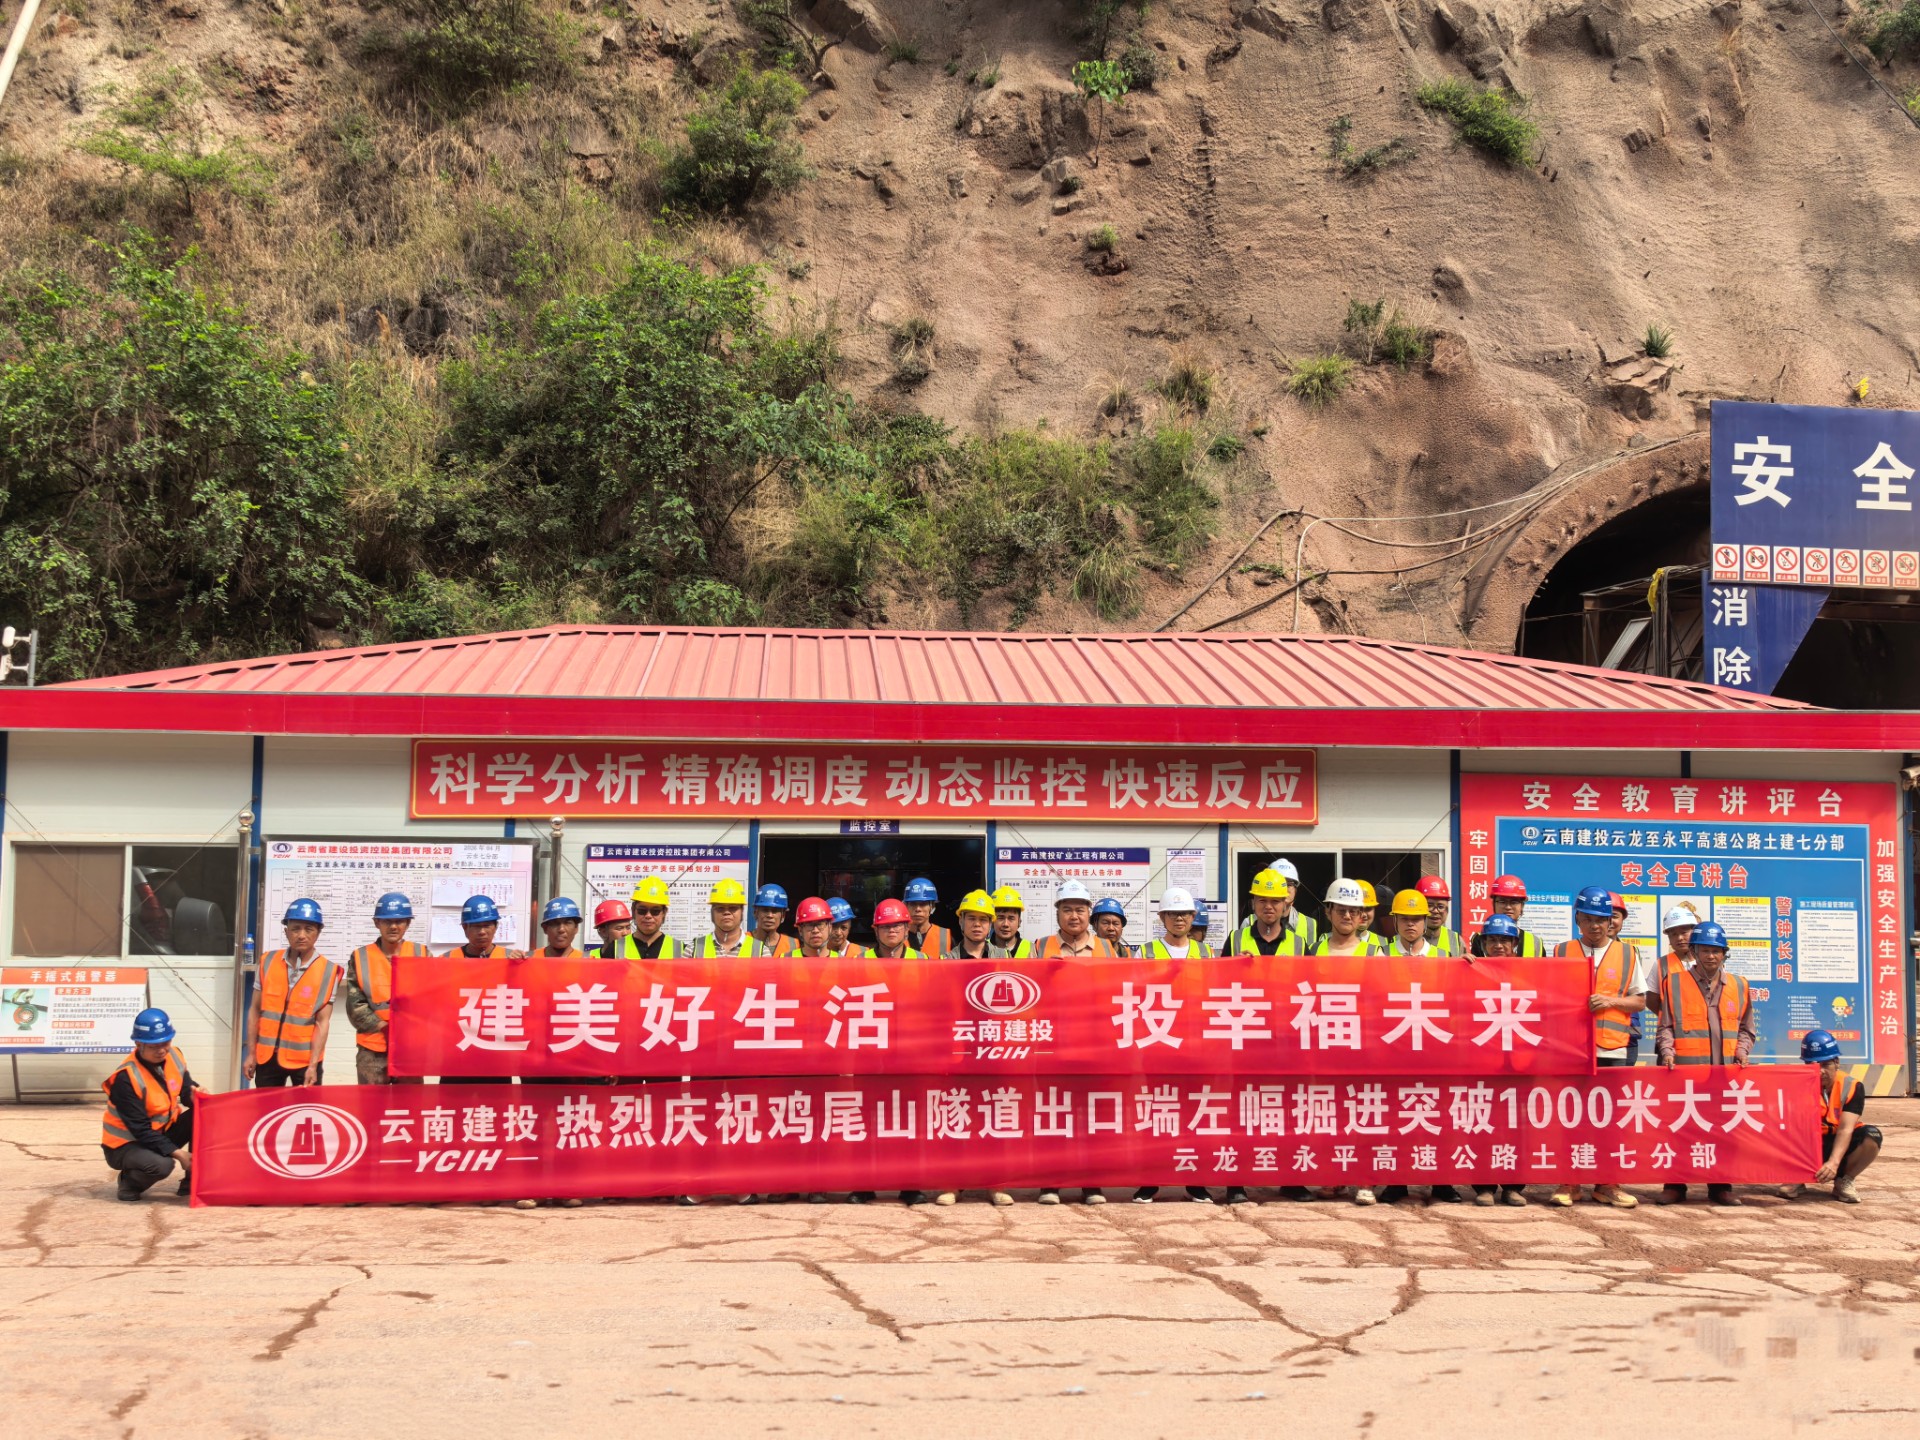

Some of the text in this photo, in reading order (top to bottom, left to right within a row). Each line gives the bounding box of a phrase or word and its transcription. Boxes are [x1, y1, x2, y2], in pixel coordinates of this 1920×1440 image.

[1731, 436, 1916, 511] 安全
[1711, 588, 1752, 685] 消除
[429, 752, 1303, 810] 科学分析 精确调度 动态监控 快速反应
[1522, 781, 1844, 817] 安全教育讲评台
[849, 819, 891, 832] 监控室
[1542, 828, 1845, 852] 云南建投云龙至永平高速公路土建七分部
[297, 845, 453, 855] 云南省建设投资控股集团有限公司
[606, 848, 731, 857] 云南省建设投资控股集团有限公司
[1021, 852, 1125, 861] 云南建投矿业工程有限公司
[624, 865, 720, 873] 安全生产责任网格划分图
[1023, 868, 1123, 876] 安全生产区域责任人告示牌
[1620, 861, 1750, 890] 安全宣讲台
[1469, 829, 1489, 950] 牢固树立
[1775, 896, 1793, 983] 警钟长鸣
[1876, 838, 1899, 1035] 加强安全生产法治
[30, 970, 118, 983] 手摇式报警器
[456, 980, 1543, 1055] 建美好生活 投幸福未来
[952, 1018, 1055, 1043] 云南建投
[975, 1045, 1030, 1060] YCIH
[379, 1104, 539, 1145] 云南建投
[555, 1080, 1787, 1149] 热烈庆祝鸡尾山隧道出口端左幅掘进突破1000米大关！
[414, 1149, 502, 1173] YCIH
[1173, 1141, 1718, 1173] 云龙至永平高速公路土建七分部
